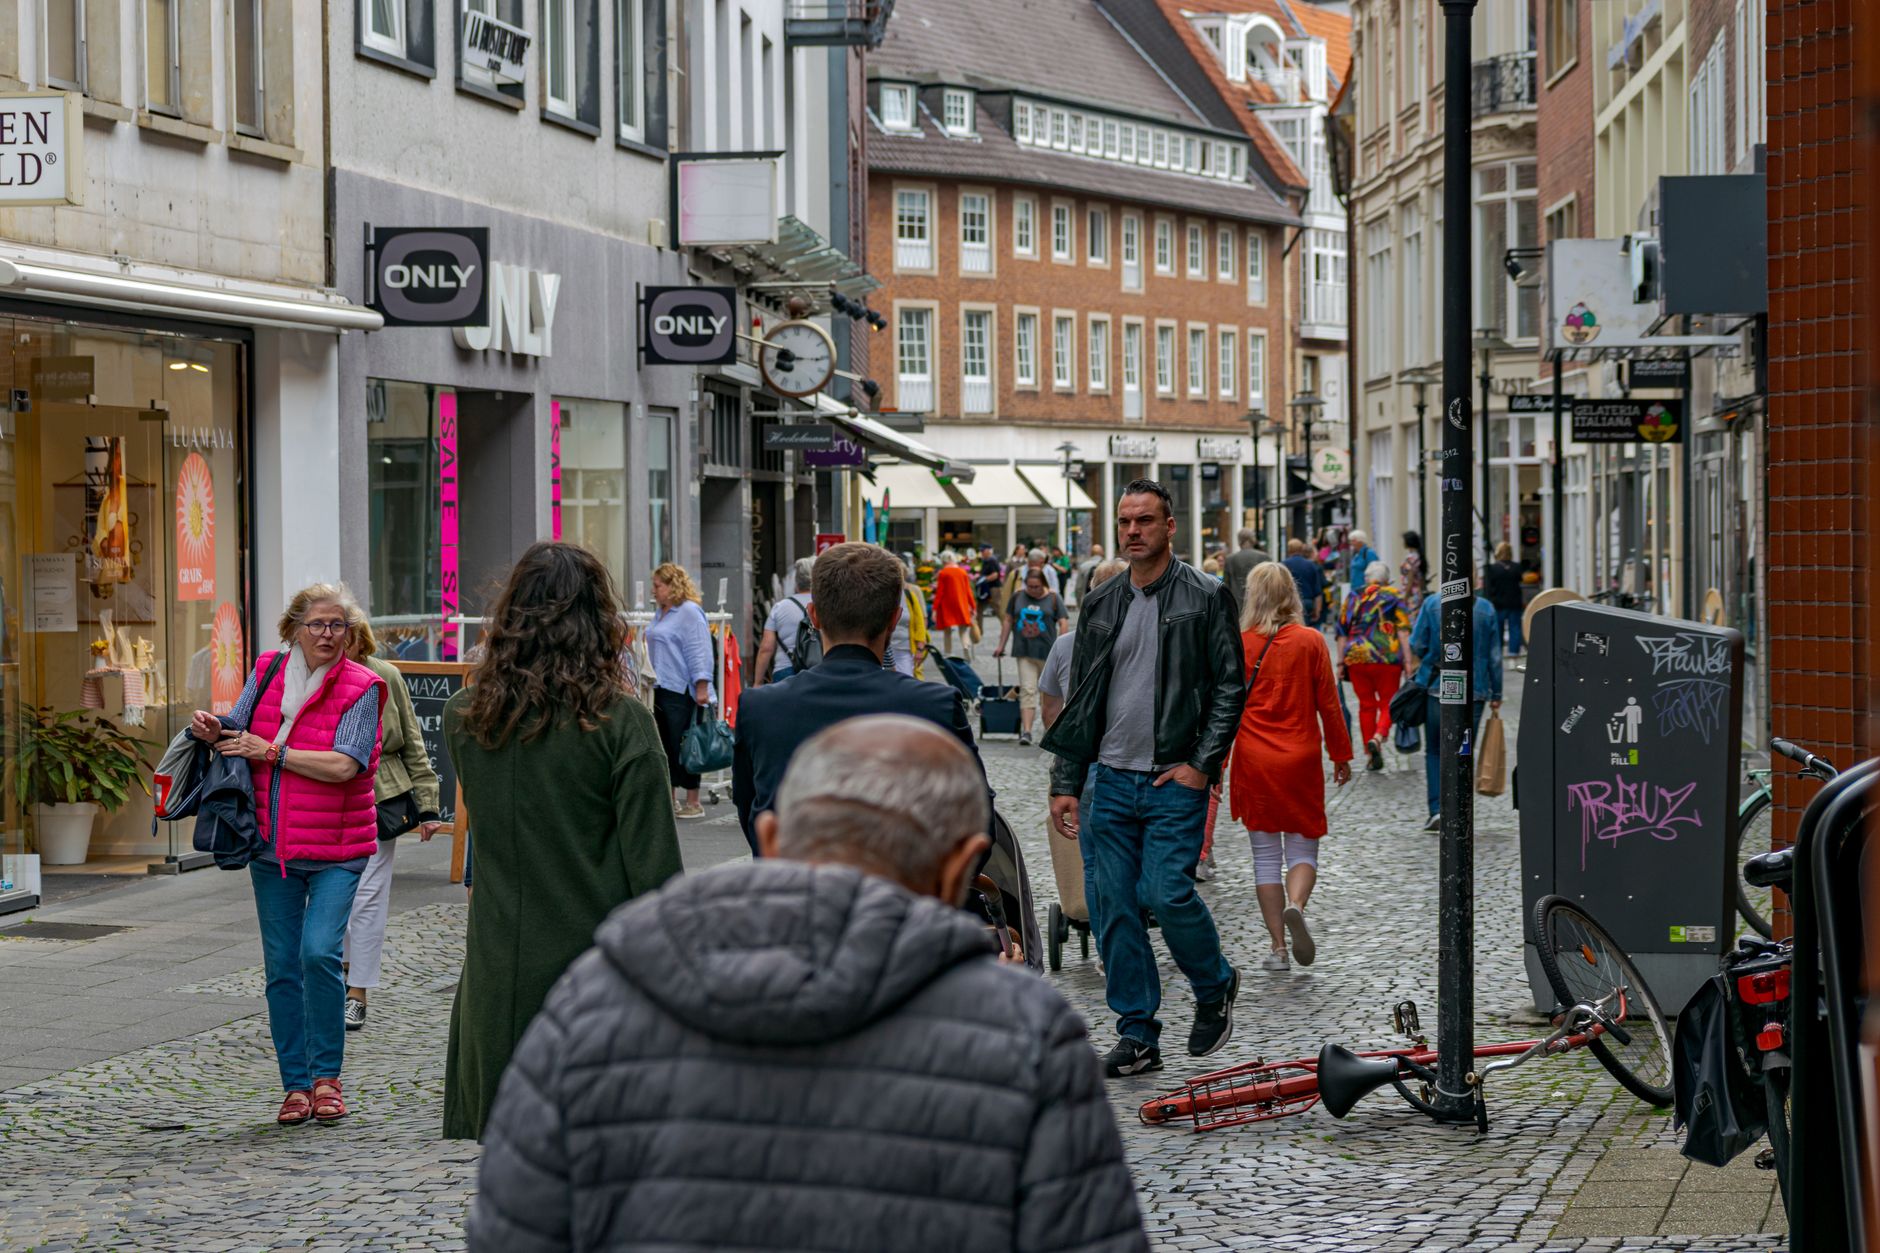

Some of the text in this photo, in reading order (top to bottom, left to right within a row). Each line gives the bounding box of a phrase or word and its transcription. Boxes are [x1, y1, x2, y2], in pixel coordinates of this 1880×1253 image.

[0, 111, 51, 145] EN
[384, 264, 475, 288] ONLY
[452, 261, 561, 358] NLY
[654, 315, 728, 335] ONLY
[1574, 404, 1641, 416] GELATERIA
[1574, 416, 1632, 427] ITALIANA
[173, 424, 234, 449] LUAMAYA
[441, 416, 456, 520] SALE
[1611, 757, 1629, 766] FILL
